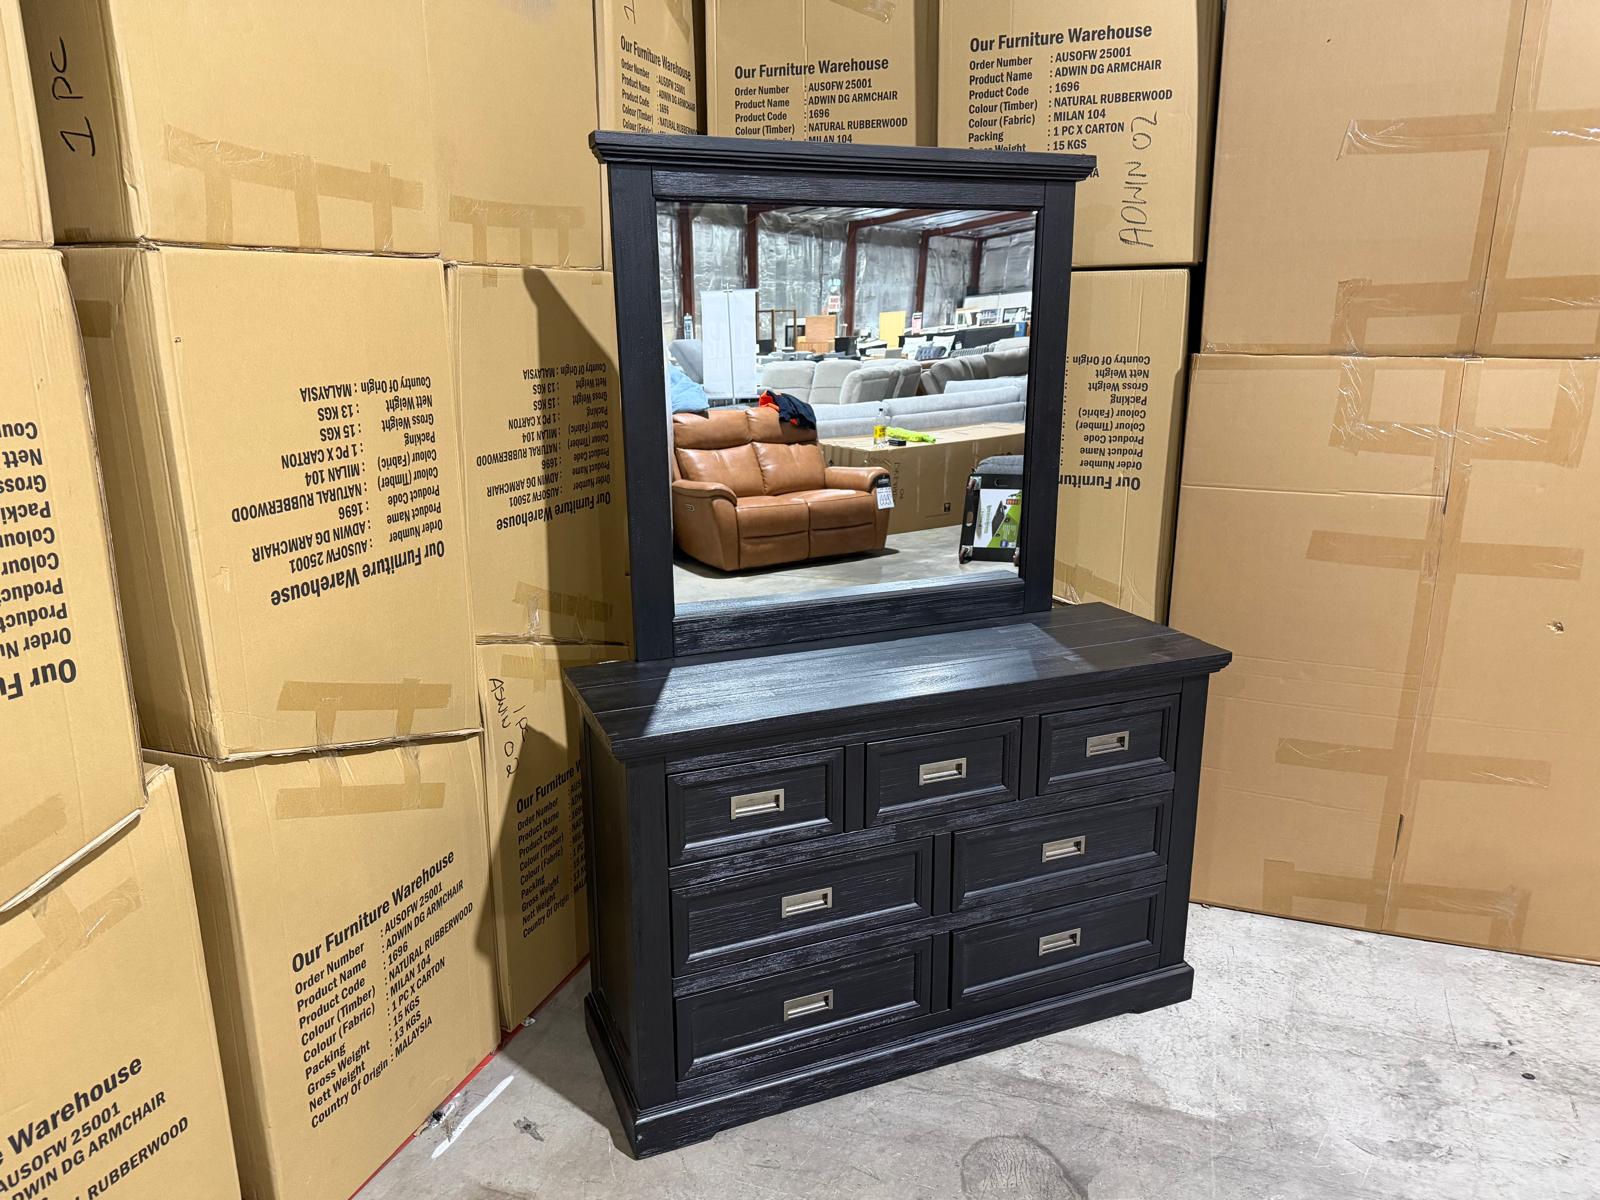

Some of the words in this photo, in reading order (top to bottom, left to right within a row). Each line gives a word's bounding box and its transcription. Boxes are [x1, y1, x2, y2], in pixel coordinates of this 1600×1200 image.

[970, 37, 995, 52] Our
[998, 32, 1064, 49] Furniture
[1068, 25, 1152, 42] Warehouse
[969, 59, 994, 70] Order
[996, 56, 1032, 68] Number
[1055, 49, 1097, 62] AUSOFW
[1099, 46, 1131, 59] 25001
[734, 66, 756, 79] Our
[759, 62, 815, 77] Furniture
[818, 58, 888, 73] Warehouse
[969, 72, 1004, 85] Product
[1006, 71, 1032, 82] Name
[1054, 65, 1087, 77] ADWIN
[1090, 63, 1104, 74] DG
[1106, 59, 1161, 73] ARMCHAIR
[734, 86, 756, 96] Order
[758, 85, 789, 95] Number
[808, 80, 844, 92] AUSOFW
[845, 78, 872, 89] 25001
[968, 87, 1004, 100] Product
[1005, 85, 1029, 96] Code
[1055, 81, 1079, 92] 1696
[808, 94, 836, 105] ADWIN
[851, 90, 897, 102] ARMCHAIR
[968, 103, 998, 114] Colour
[999, 99, 1038, 113] (Timber)
[1054, 94, 1098, 107] NATURAL
[1100, 89, 1172, 104] RUBBERWOOD
[809, 108, 830, 119] 1696
[968, 117, 997, 128] Colour
[999, 114, 1035, 128] (Fabric)
[1053, 110, 1084, 122] MILAN
[1087, 108, 1106, 119] 104
[762, 124, 795, 136] (Timber)
[808, 121, 845, 132] NATURAL
[847, 117, 907, 130] RUBBERWOOD
[968, 131, 1004, 142] Packing
[1084, 122, 1124, 134] CARTON
[837, 134, 852, 143] 104
[1053, 140, 1065, 150] 15
[1067, 138, 1086, 149] KGS
[1072, 354, 1100, 365] Origin
[1113, 354, 1150, 365] Country
[522, 367, 555, 380] MALAYSIA
[1095, 367, 1127, 378] Weight
[1129, 369, 1149, 378] Nett
[360, 378, 387, 395] Origin
[400, 376, 431, 390] Country
[1088, 380, 1120, 392] Weight
[1121, 382, 1148, 392] Gross
[299, 384, 352, 402] MALAYSIA
[1110, 393, 1147, 406] Packing
[411, 413, 434, 425] Gross
[1078, 407, 1114, 418] (Fabric)
[1115, 409, 1146, 419] Colour
[381, 415, 411, 432] Weight
[1075, 420, 1113, 431] (Timber)
[1114, 422, 1145, 432] Colour
[403, 431, 435, 446] Packing
[1083, 434, 1106, 444] Code
[1108, 435, 1144, 445] Product
[2, 448, 42, 468] Nett
[281, 449, 324, 469] CARTON
[377, 451, 410, 471] (Fabric)
[476, 448, 527, 466] RUBBERWOOD
[1079, 447, 1105, 456] Name
[1107, 448, 1143, 457] Product
[327, 463, 360, 482] MILAN
[1079, 459, 1115, 469] Number
[1116, 460, 1142, 470] Order
[304, 469, 325, 486] 104
[377, 469, 412, 491] (Timber)
[1059, 474, 1112, 489] Furnitur
[1115, 476, 1140, 490] Our
[316, 483, 362, 504] NATURAL
[486, 478, 525, 497] ARMCHAIR
[554, 495, 594, 515] Furniture
[596, 491, 611, 504] Our
[1, 501, 52, 524] Packi
[231, 493, 314, 522] RUBBERWOOD
[338, 502, 363, 520] 1696
[421, 519, 443, 533] Order
[496, 506, 553, 530] Warehouse
[315, 529, 330, 545] DG
[332, 521, 365, 541] ADWIN
[389, 525, 420, 542] Number
[252, 534, 312, 562] ARMCHAIR
[326, 540, 367, 563] AUSOFW
[424, 540, 444, 558] Our
[1, 552, 59, 575] Colour
[289, 551, 323, 573] 25001
[362, 547, 421, 577] Furniture
[0, 578, 64, 606] Produc
[271, 568, 359, 605] Warehouse
[0, 602, 68, 632] Product
[23, 628, 72, 651] Order
[30, 658, 77, 687] Our
[292, 944, 321, 972] Our
[326, 901, 389, 951] Furniture
[392, 851, 454, 904] Warehouse
[386, 920, 412, 950] ADWIN
[413, 911, 425, 927] DG
[426, 880, 463, 918] ARMCHAIR
[295, 969, 324, 994] Order
[326, 943, 364, 975] Number
[384, 900, 418, 934] AUSOFW
[419, 882, 442, 907] 25001
[336, 985, 375, 1022] (Timber)
[388, 945, 423, 981] NATURAL
[424, 903, 473, 950] RUBBERWOOD
[388, 941, 408, 966] 1696
[338, 1002, 375, 1039] (Fabric)
[390, 967, 415, 996] MILAN
[416, 953, 431, 974] 104
[305, 1042, 346, 1080] Packing
[416, 956, 445, 989] CARTON
[307, 1068, 336, 1095] Gross
[337, 1040, 370, 1072] Weight
[311, 1091, 349, 1128] Country
[362, 1059, 388, 1085] Origin
[394, 1016, 432, 1057] MALAYSIA
[8, 1058, 142, 1155] Warehouse
[0, 1136, 67, 1192] AUSOFW
[71, 1102, 121, 1145] 25001
[12, 1168, 58, 1200] DWIN
[61, 1150, 85, 1175] DG
[88, 1091, 166, 1157] ARMCHAIR
[87, 1117, 188, 1200] RUBBERWOOD
